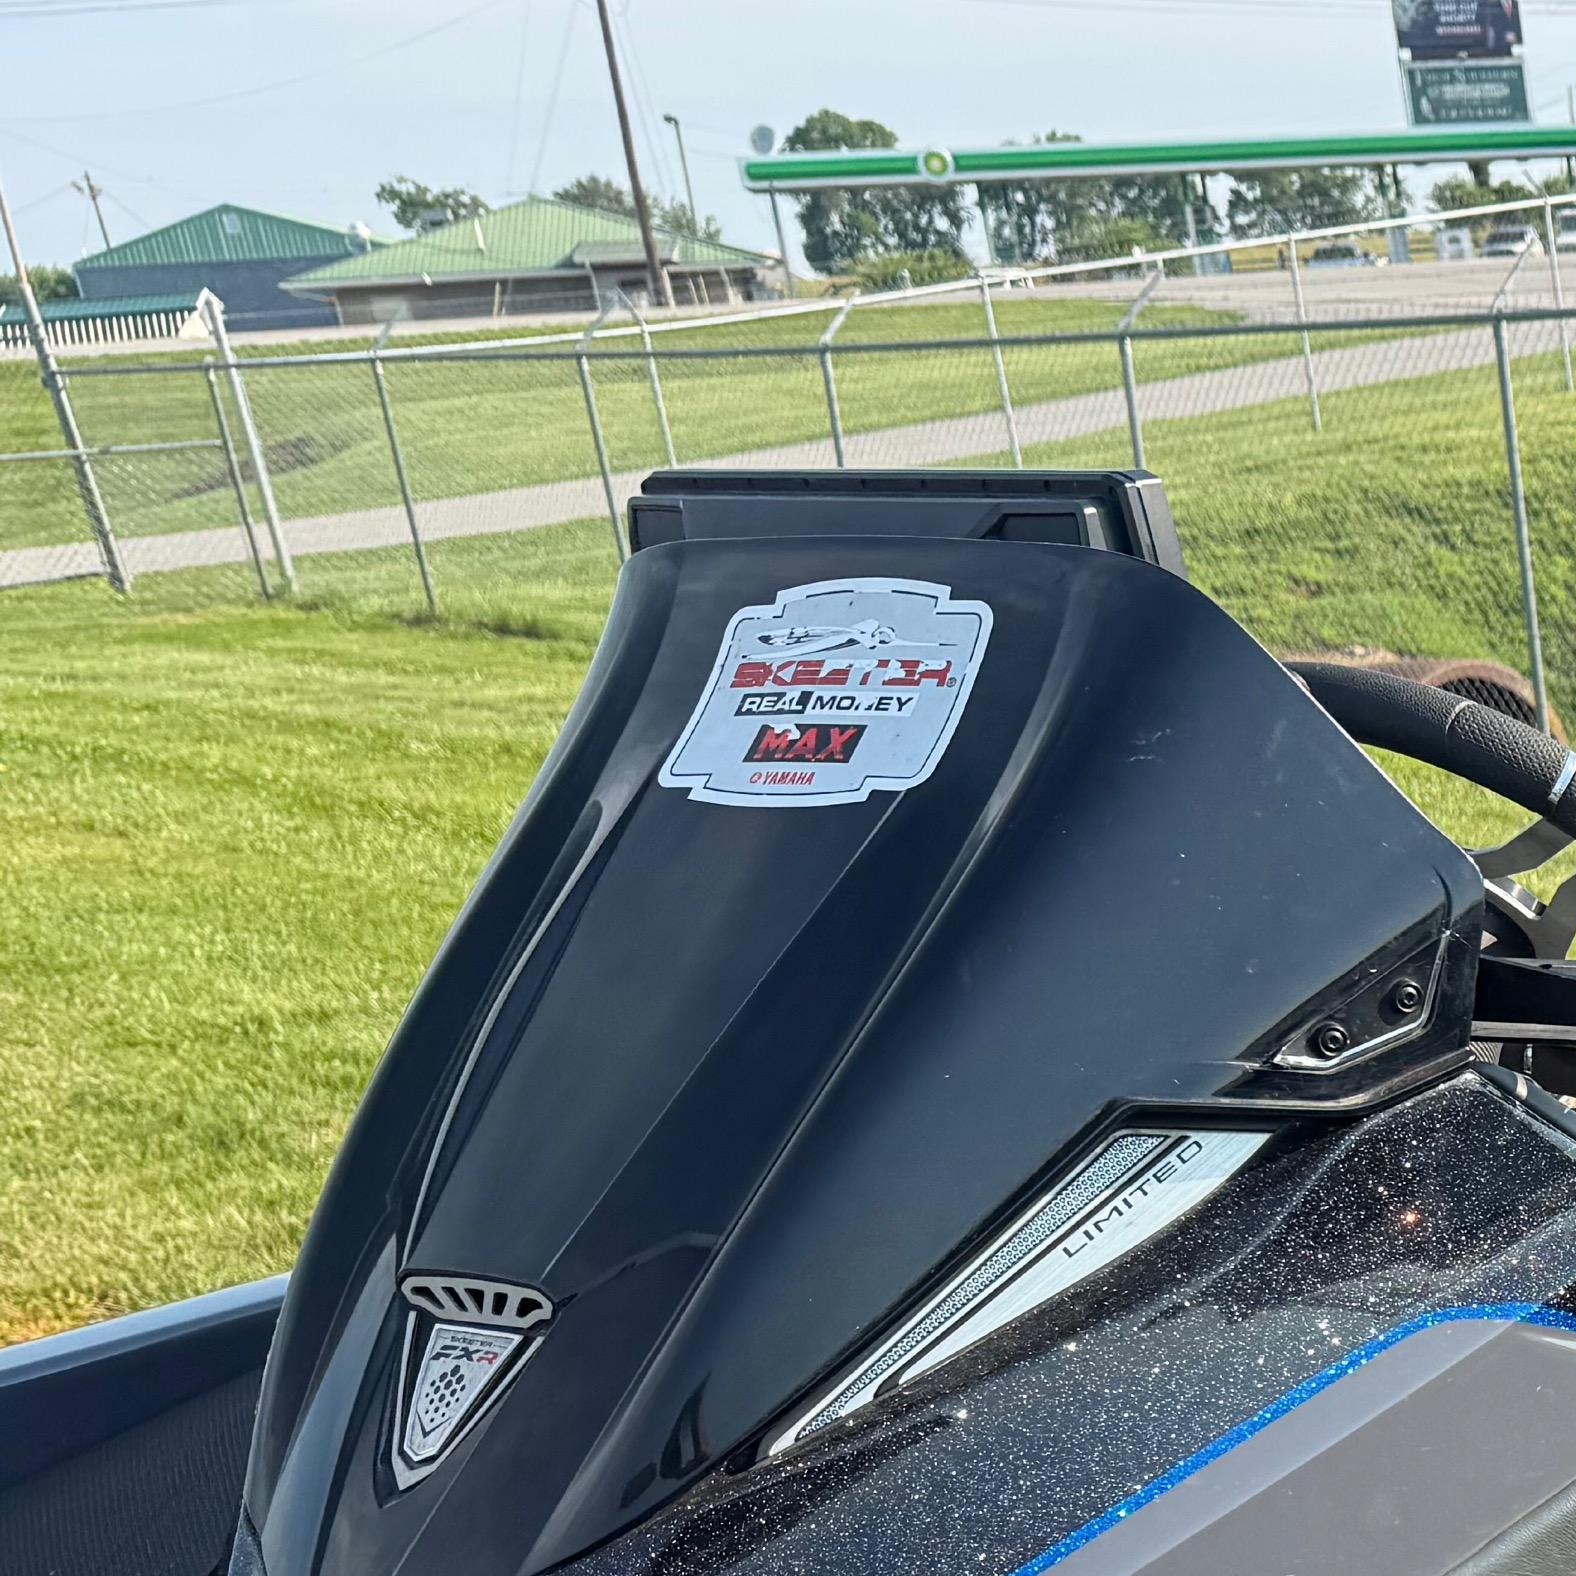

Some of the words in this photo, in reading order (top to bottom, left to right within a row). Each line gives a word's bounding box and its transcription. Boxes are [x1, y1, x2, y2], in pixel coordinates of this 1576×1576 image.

[741, 696, 804, 713] REAL
[753, 727, 858, 760] MAX
[762, 771, 816, 785] YAMAHA
[1061, 1140, 1203, 1259] LIMITED
[428, 1344, 499, 1365] FXR
